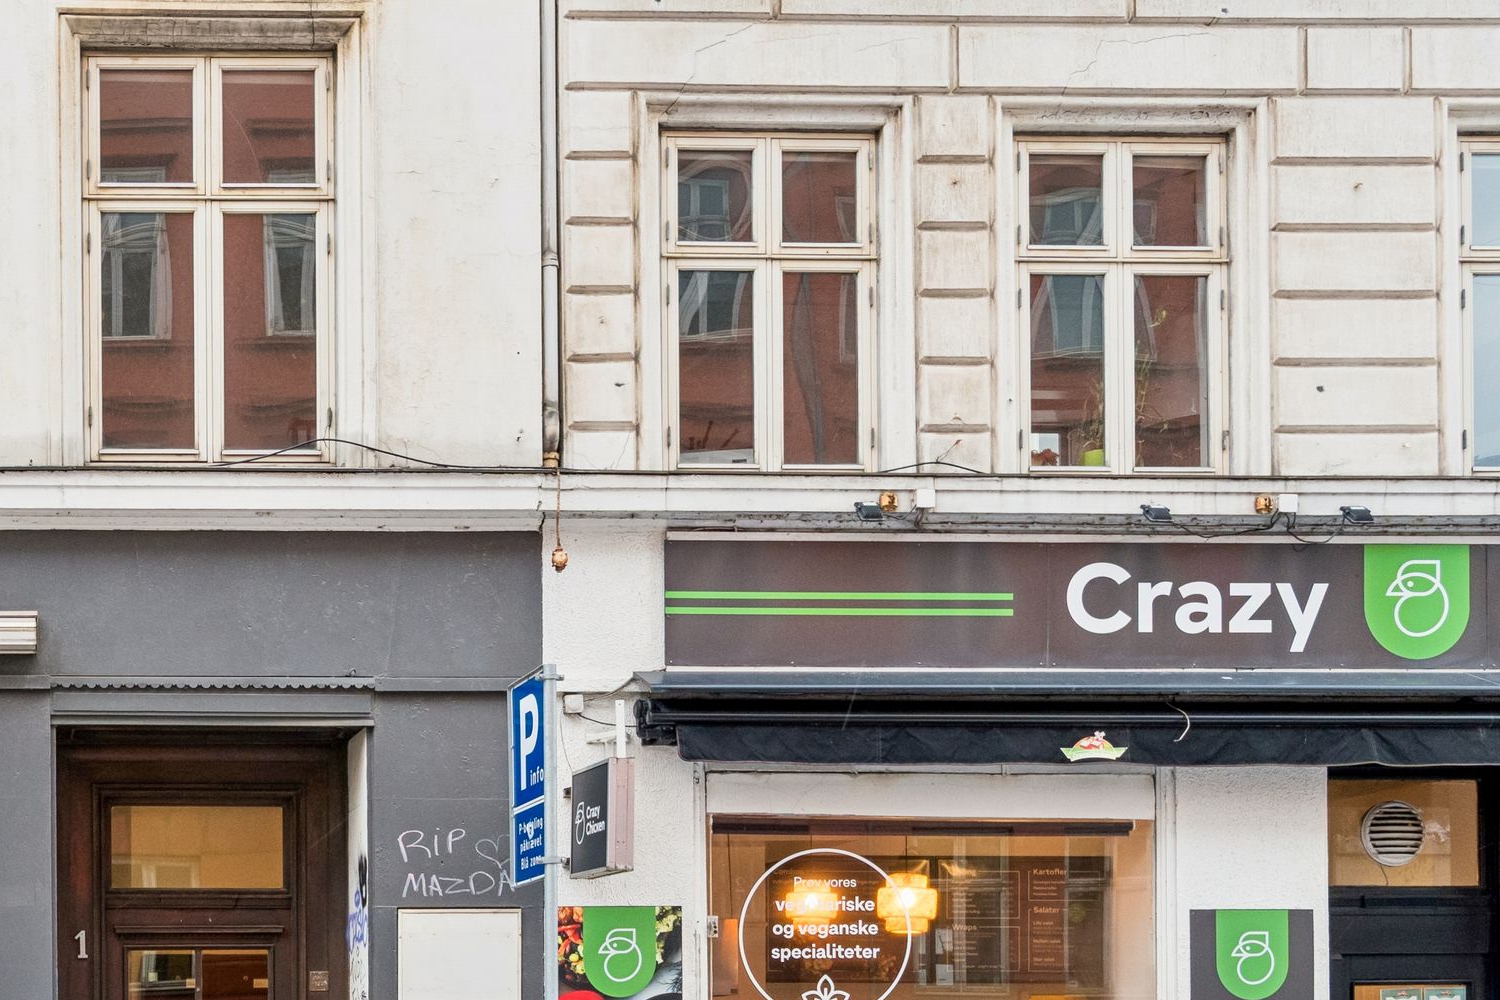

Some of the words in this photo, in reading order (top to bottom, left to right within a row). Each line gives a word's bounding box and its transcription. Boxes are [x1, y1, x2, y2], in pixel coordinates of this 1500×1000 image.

[1066, 562, 1330, 653] Crazy
[519, 693, 539, 791] P
[530, 766, 544, 787] info
[586, 805, 601, 820] Crazy
[402, 869, 515, 898] MAZDA
[823, 879, 857, 889] vores
[772, 923, 794, 939] og
[798, 919, 879, 939] veganske
[74, 930, 89, 959] 1
[771, 943, 881, 963] specialiteter
